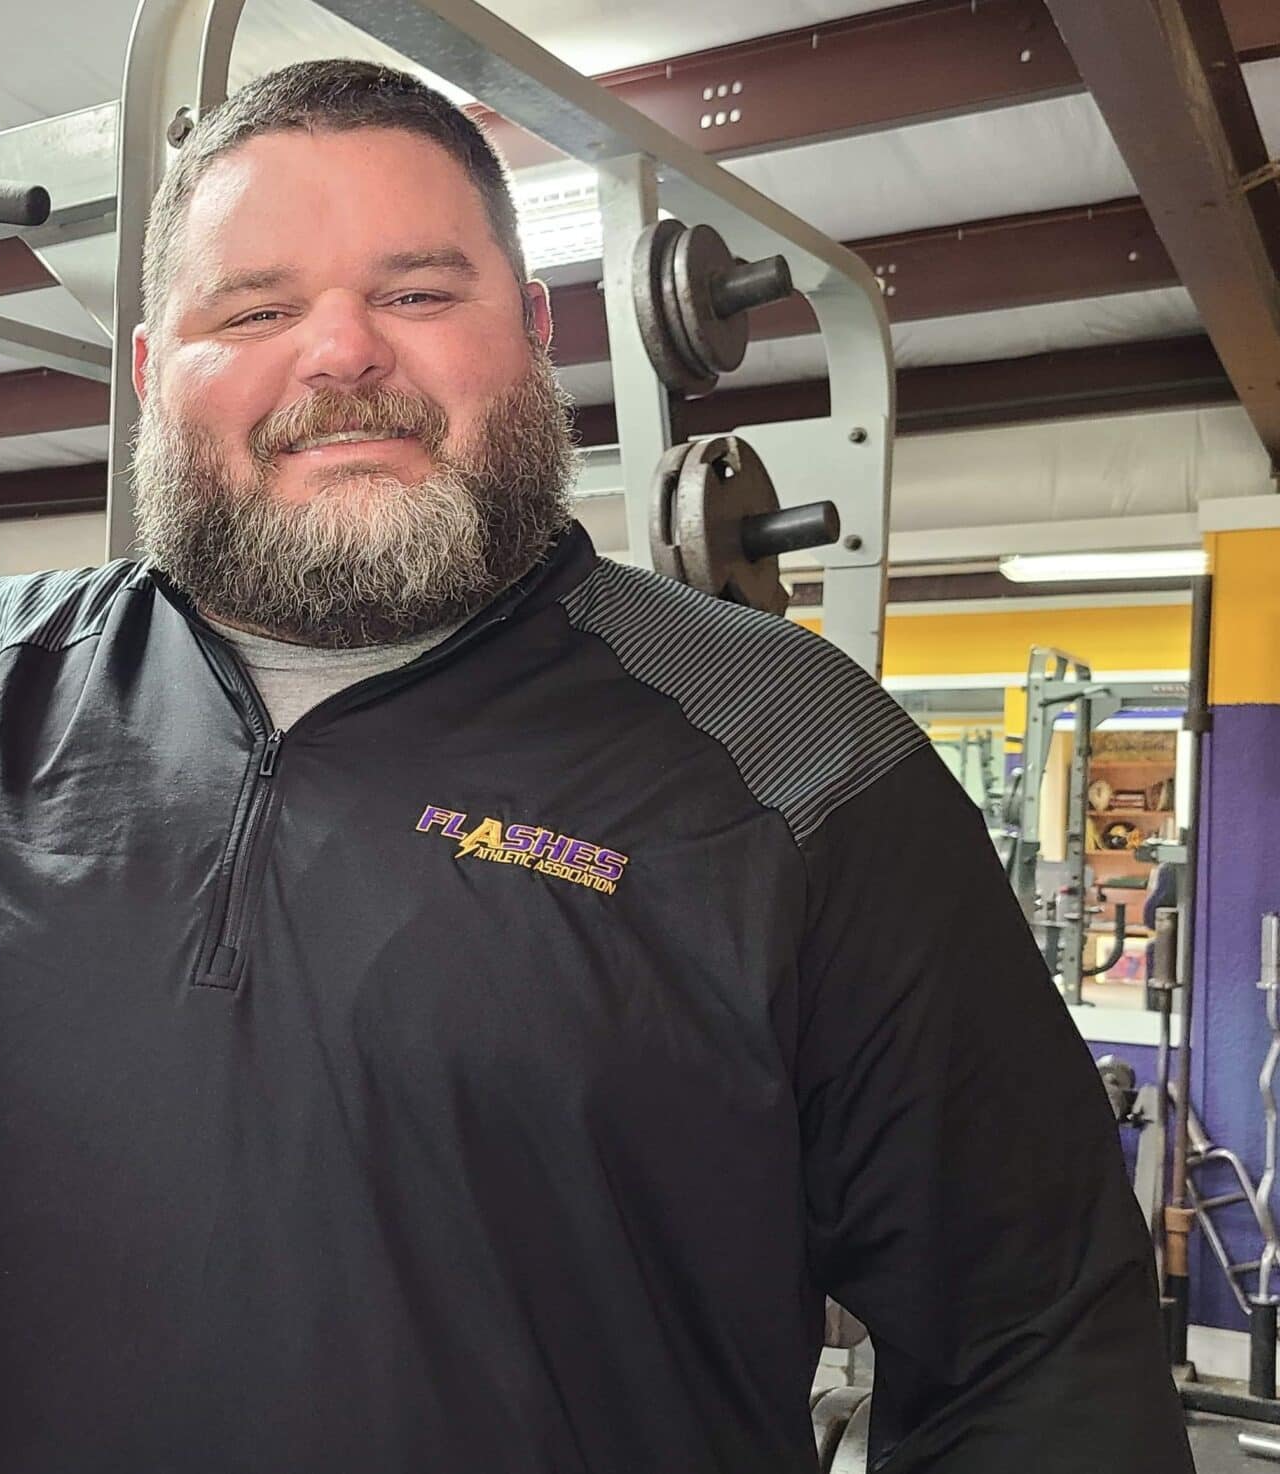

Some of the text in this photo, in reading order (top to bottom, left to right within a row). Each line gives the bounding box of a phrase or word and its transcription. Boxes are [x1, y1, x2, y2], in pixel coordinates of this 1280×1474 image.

[416, 805, 628, 881] FLASHES
[474, 846, 617, 895] ATHLETIC ASSOCIATION
